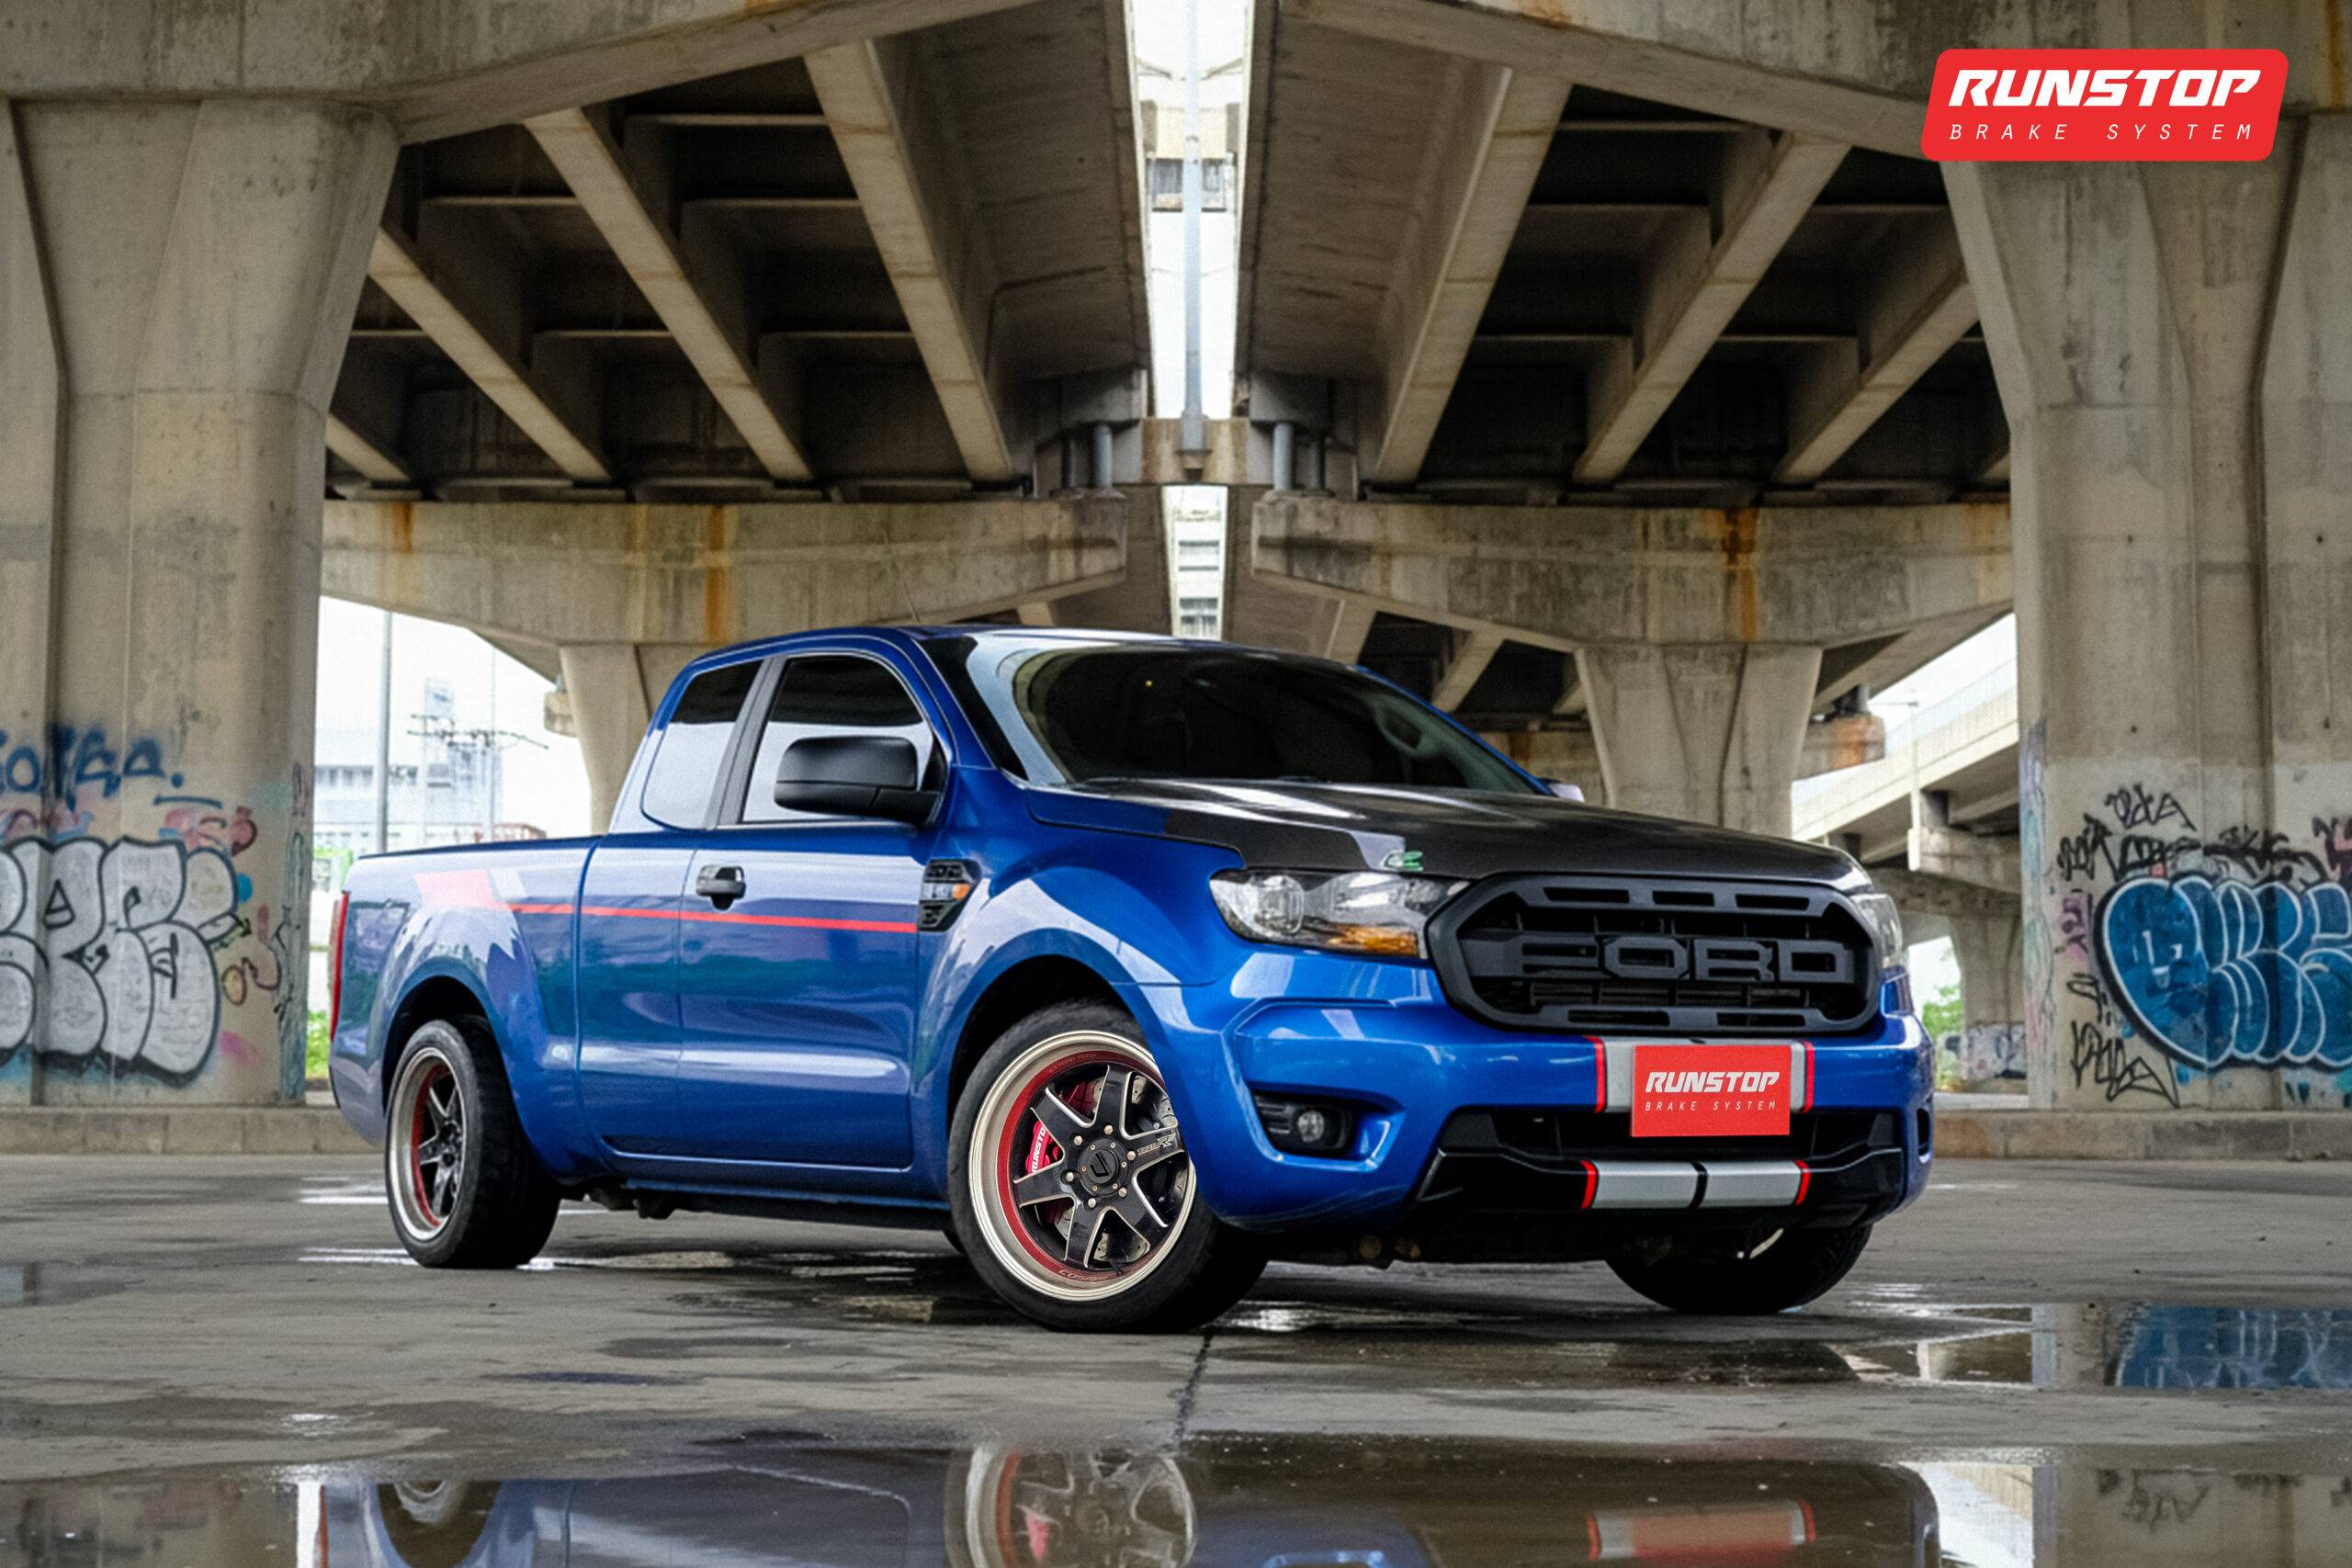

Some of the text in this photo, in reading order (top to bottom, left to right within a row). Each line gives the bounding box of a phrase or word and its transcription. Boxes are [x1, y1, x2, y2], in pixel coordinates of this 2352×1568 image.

[1505, 933, 1850, 982] FORD
[1645, 1071, 1781, 1093] RUNSTOP
[1645, 1100, 1776, 1111] BRAKE SYSTEM
[1031, 1125, 1047, 1173] RUNSTO
